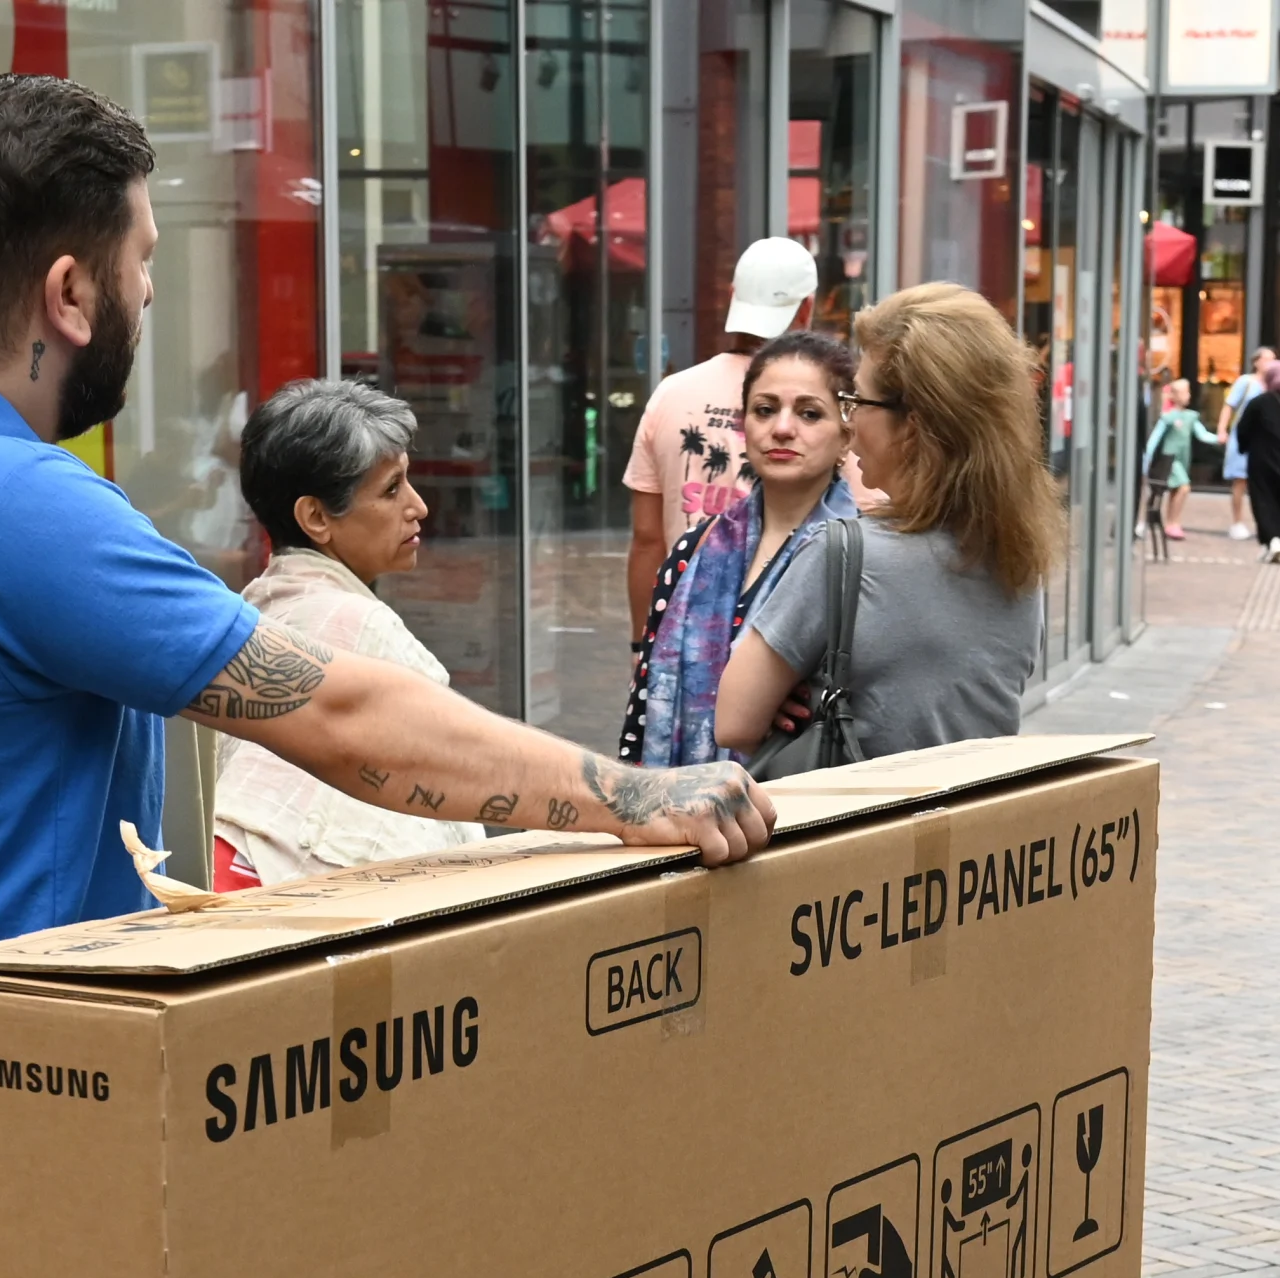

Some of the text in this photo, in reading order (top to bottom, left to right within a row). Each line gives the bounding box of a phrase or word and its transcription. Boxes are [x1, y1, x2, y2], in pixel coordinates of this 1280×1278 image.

[789, 869, 948, 976] SVC-LED
[957, 836, 1064, 928] PANEL
[607, 948, 684, 1014] BACK
[204, 994, 480, 1144] SAMSUNG
